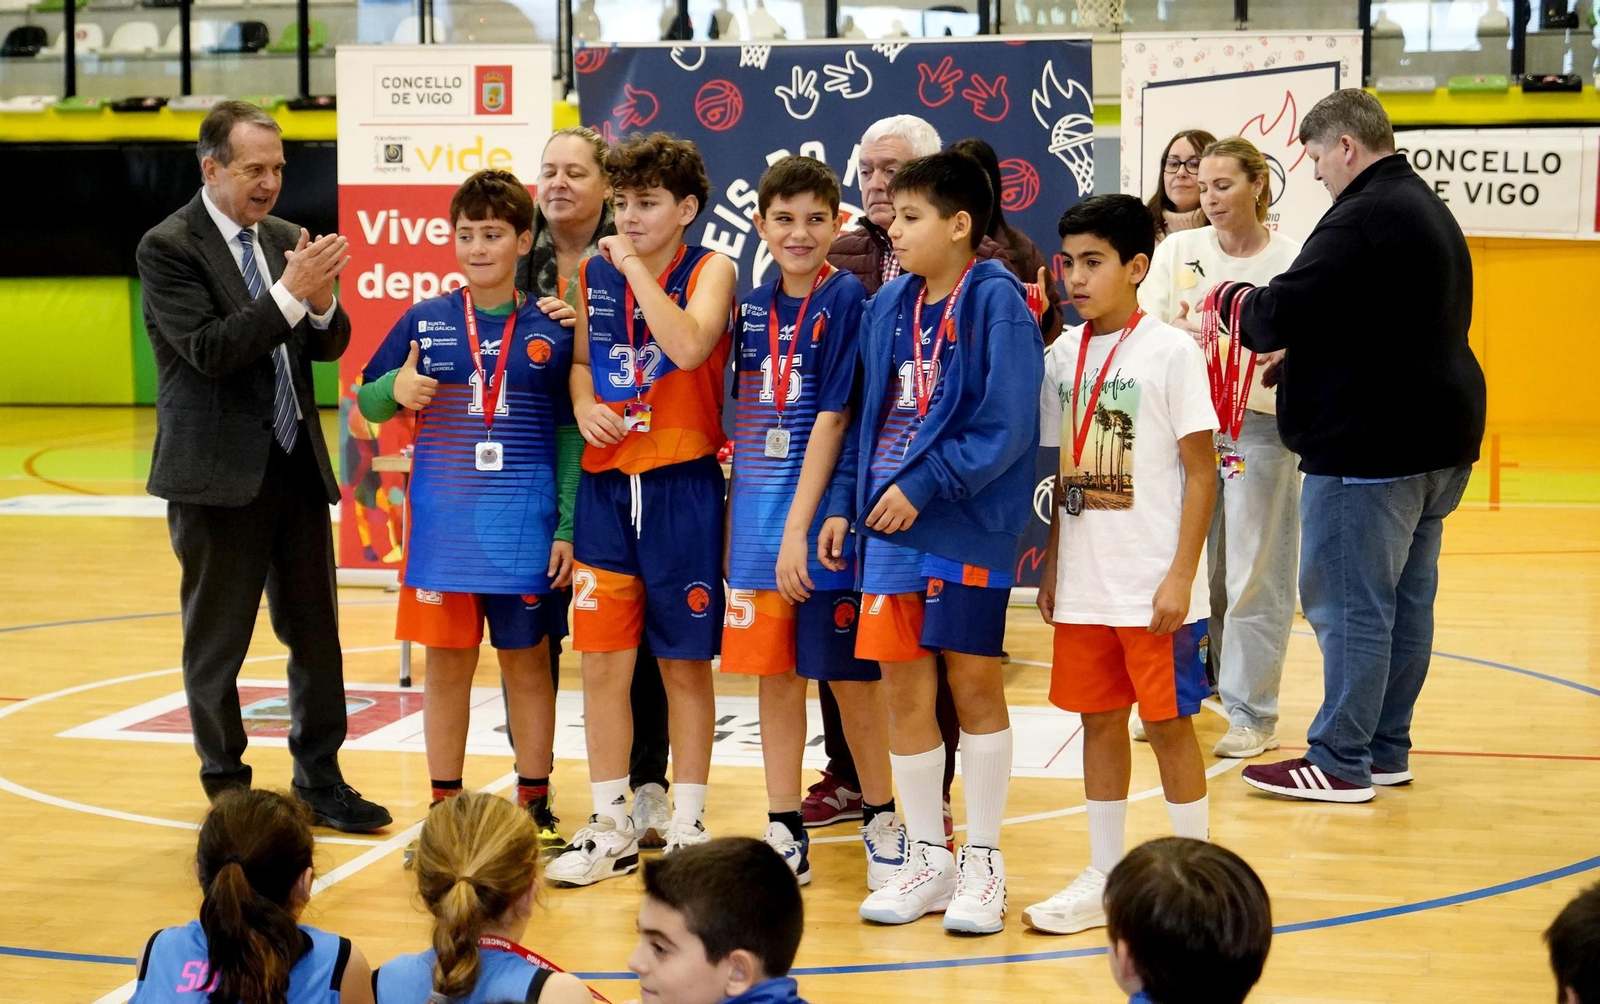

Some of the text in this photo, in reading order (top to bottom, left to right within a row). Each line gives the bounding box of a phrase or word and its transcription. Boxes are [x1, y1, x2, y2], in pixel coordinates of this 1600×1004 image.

[381, 76, 463, 89] CONCELLO
[391, 93, 453, 105] DE VIGO
[1433, 180, 1540, 206] E VIGO
[356, 208, 452, 246] Vive
[357, 263, 468, 304] depo
[608, 341, 662, 388] 32
[758, 354, 803, 404] 15
[574, 568, 599, 611] 2
[723, 588, 756, 629] 5
[478, 937, 512, 950] CONCEL
